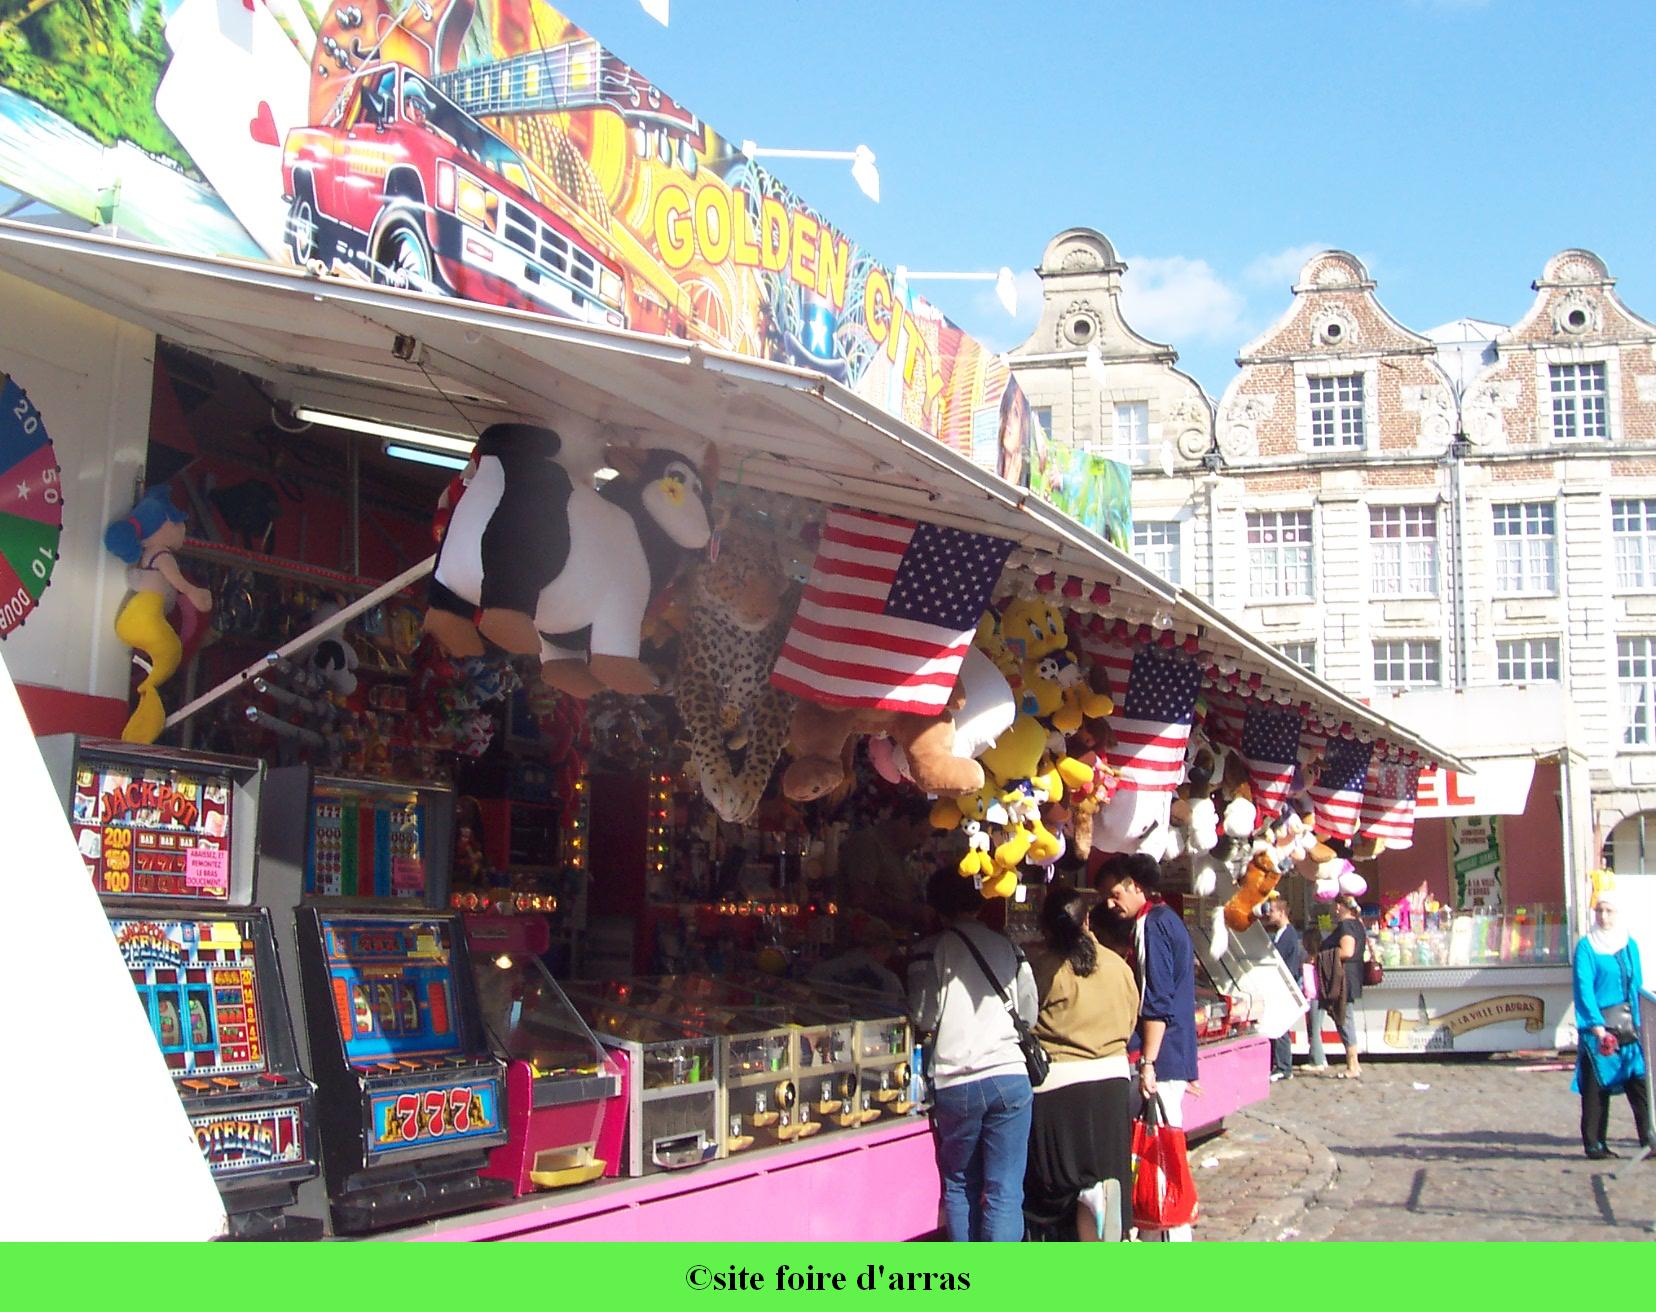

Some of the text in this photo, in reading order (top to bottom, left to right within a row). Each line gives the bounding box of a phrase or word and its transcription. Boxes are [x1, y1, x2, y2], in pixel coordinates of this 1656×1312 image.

[654, 183, 944, 415] GOLDEN CITY
[14, 399, 37, 435] 20
[42, 468, 58, 504] 50
[32, 546, 52, 578] 10
[101, 782, 199, 828] JACKPOT
[104, 828, 131, 846] 200
[104, 871, 130, 891] 100
